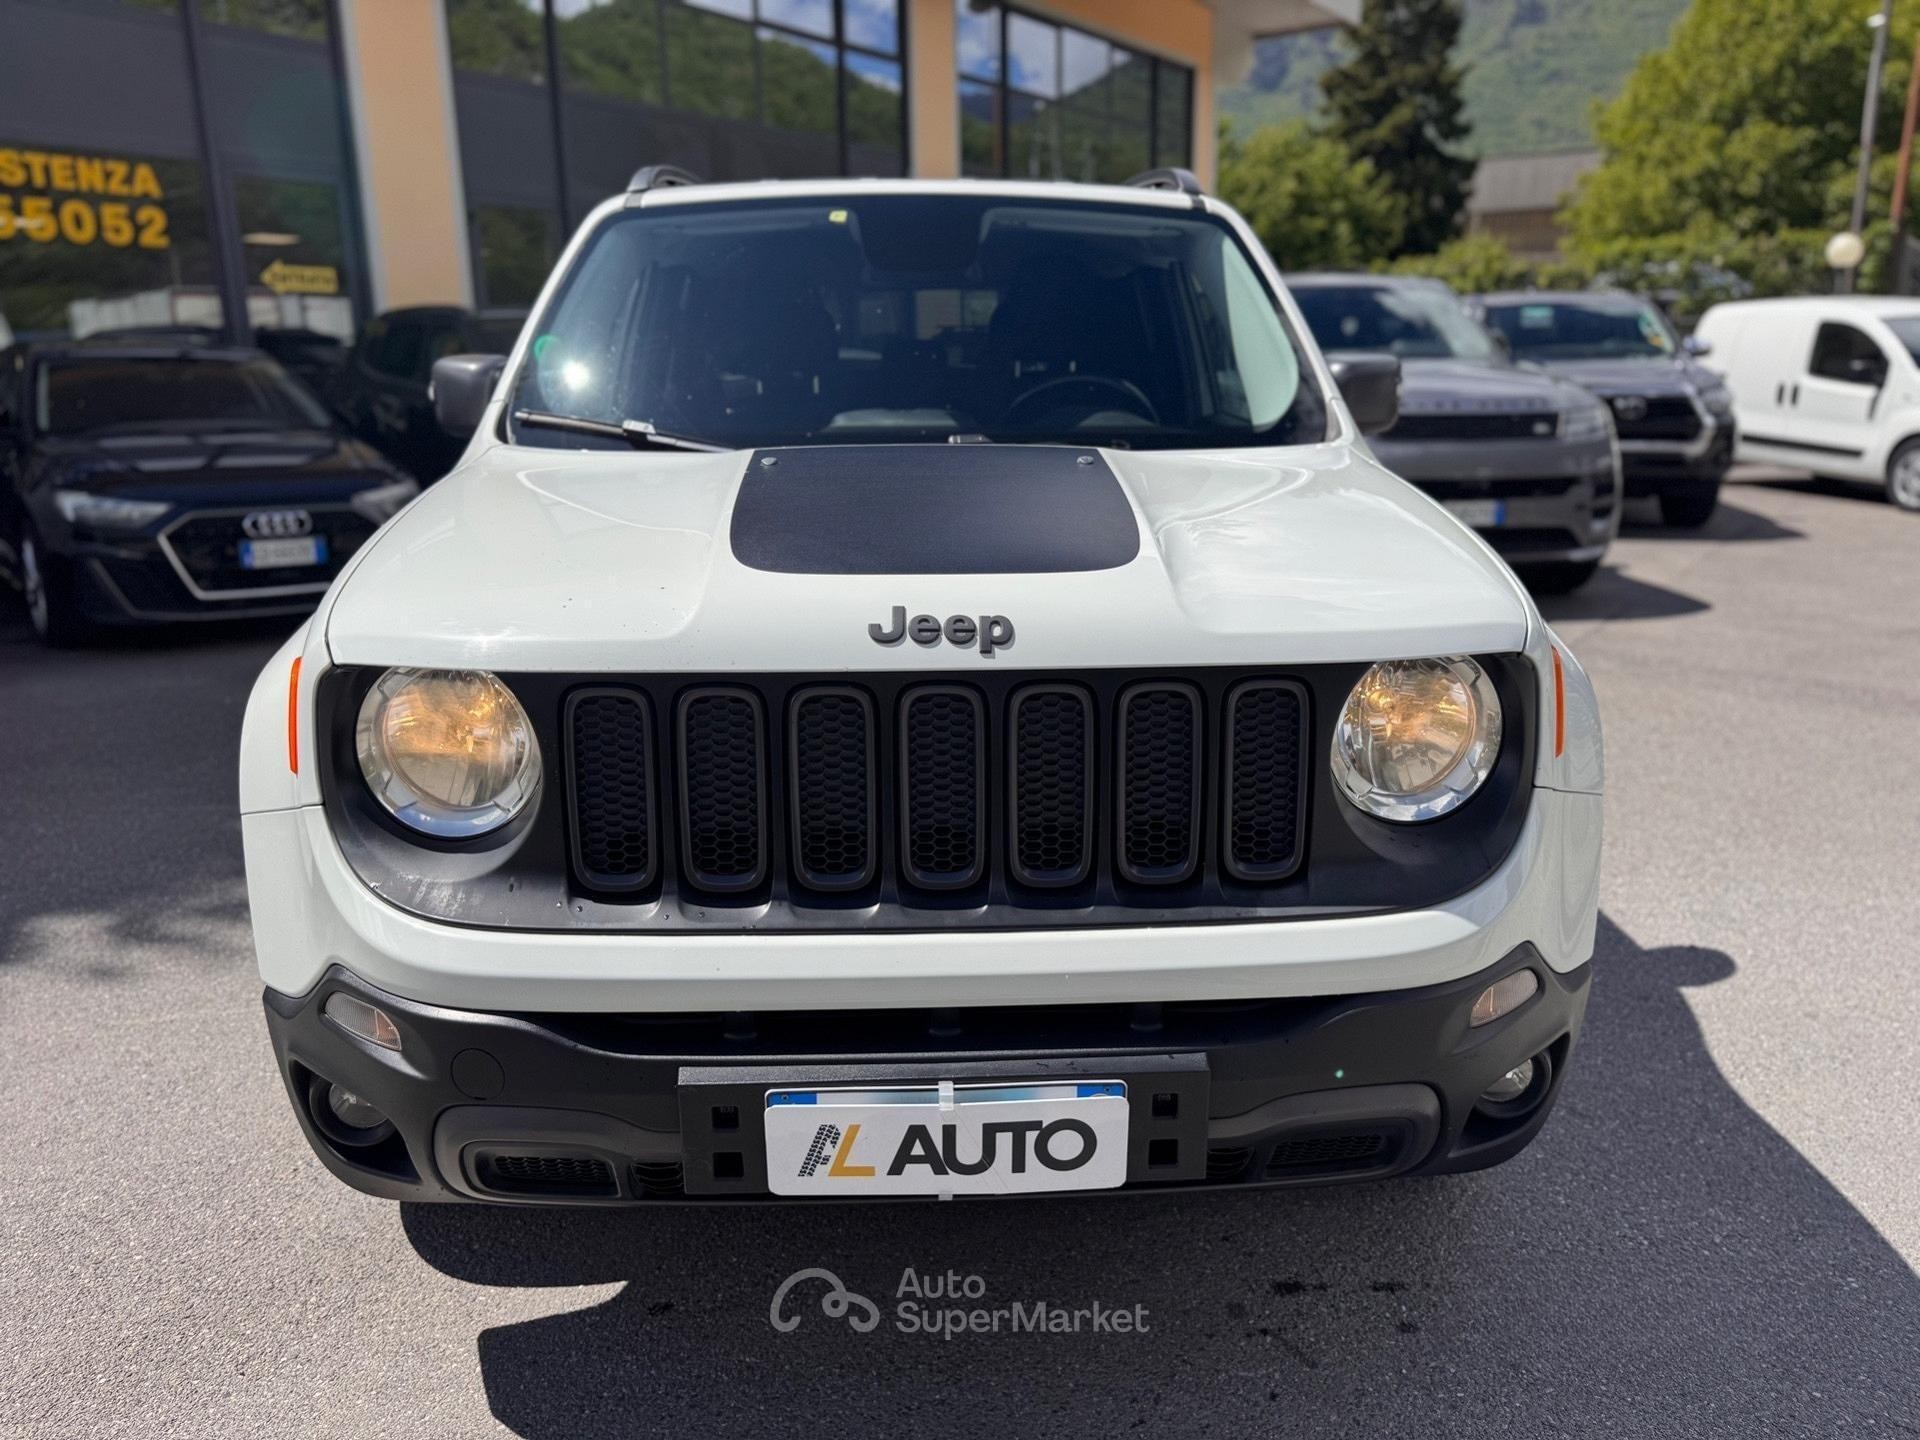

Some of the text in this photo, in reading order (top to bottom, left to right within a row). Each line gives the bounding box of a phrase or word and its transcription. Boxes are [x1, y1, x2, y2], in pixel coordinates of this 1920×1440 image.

[0, 149, 162, 198] STENZA
[868, 605, 1014, 656] Jeep
[887, 1118, 1097, 1176] AUTO
